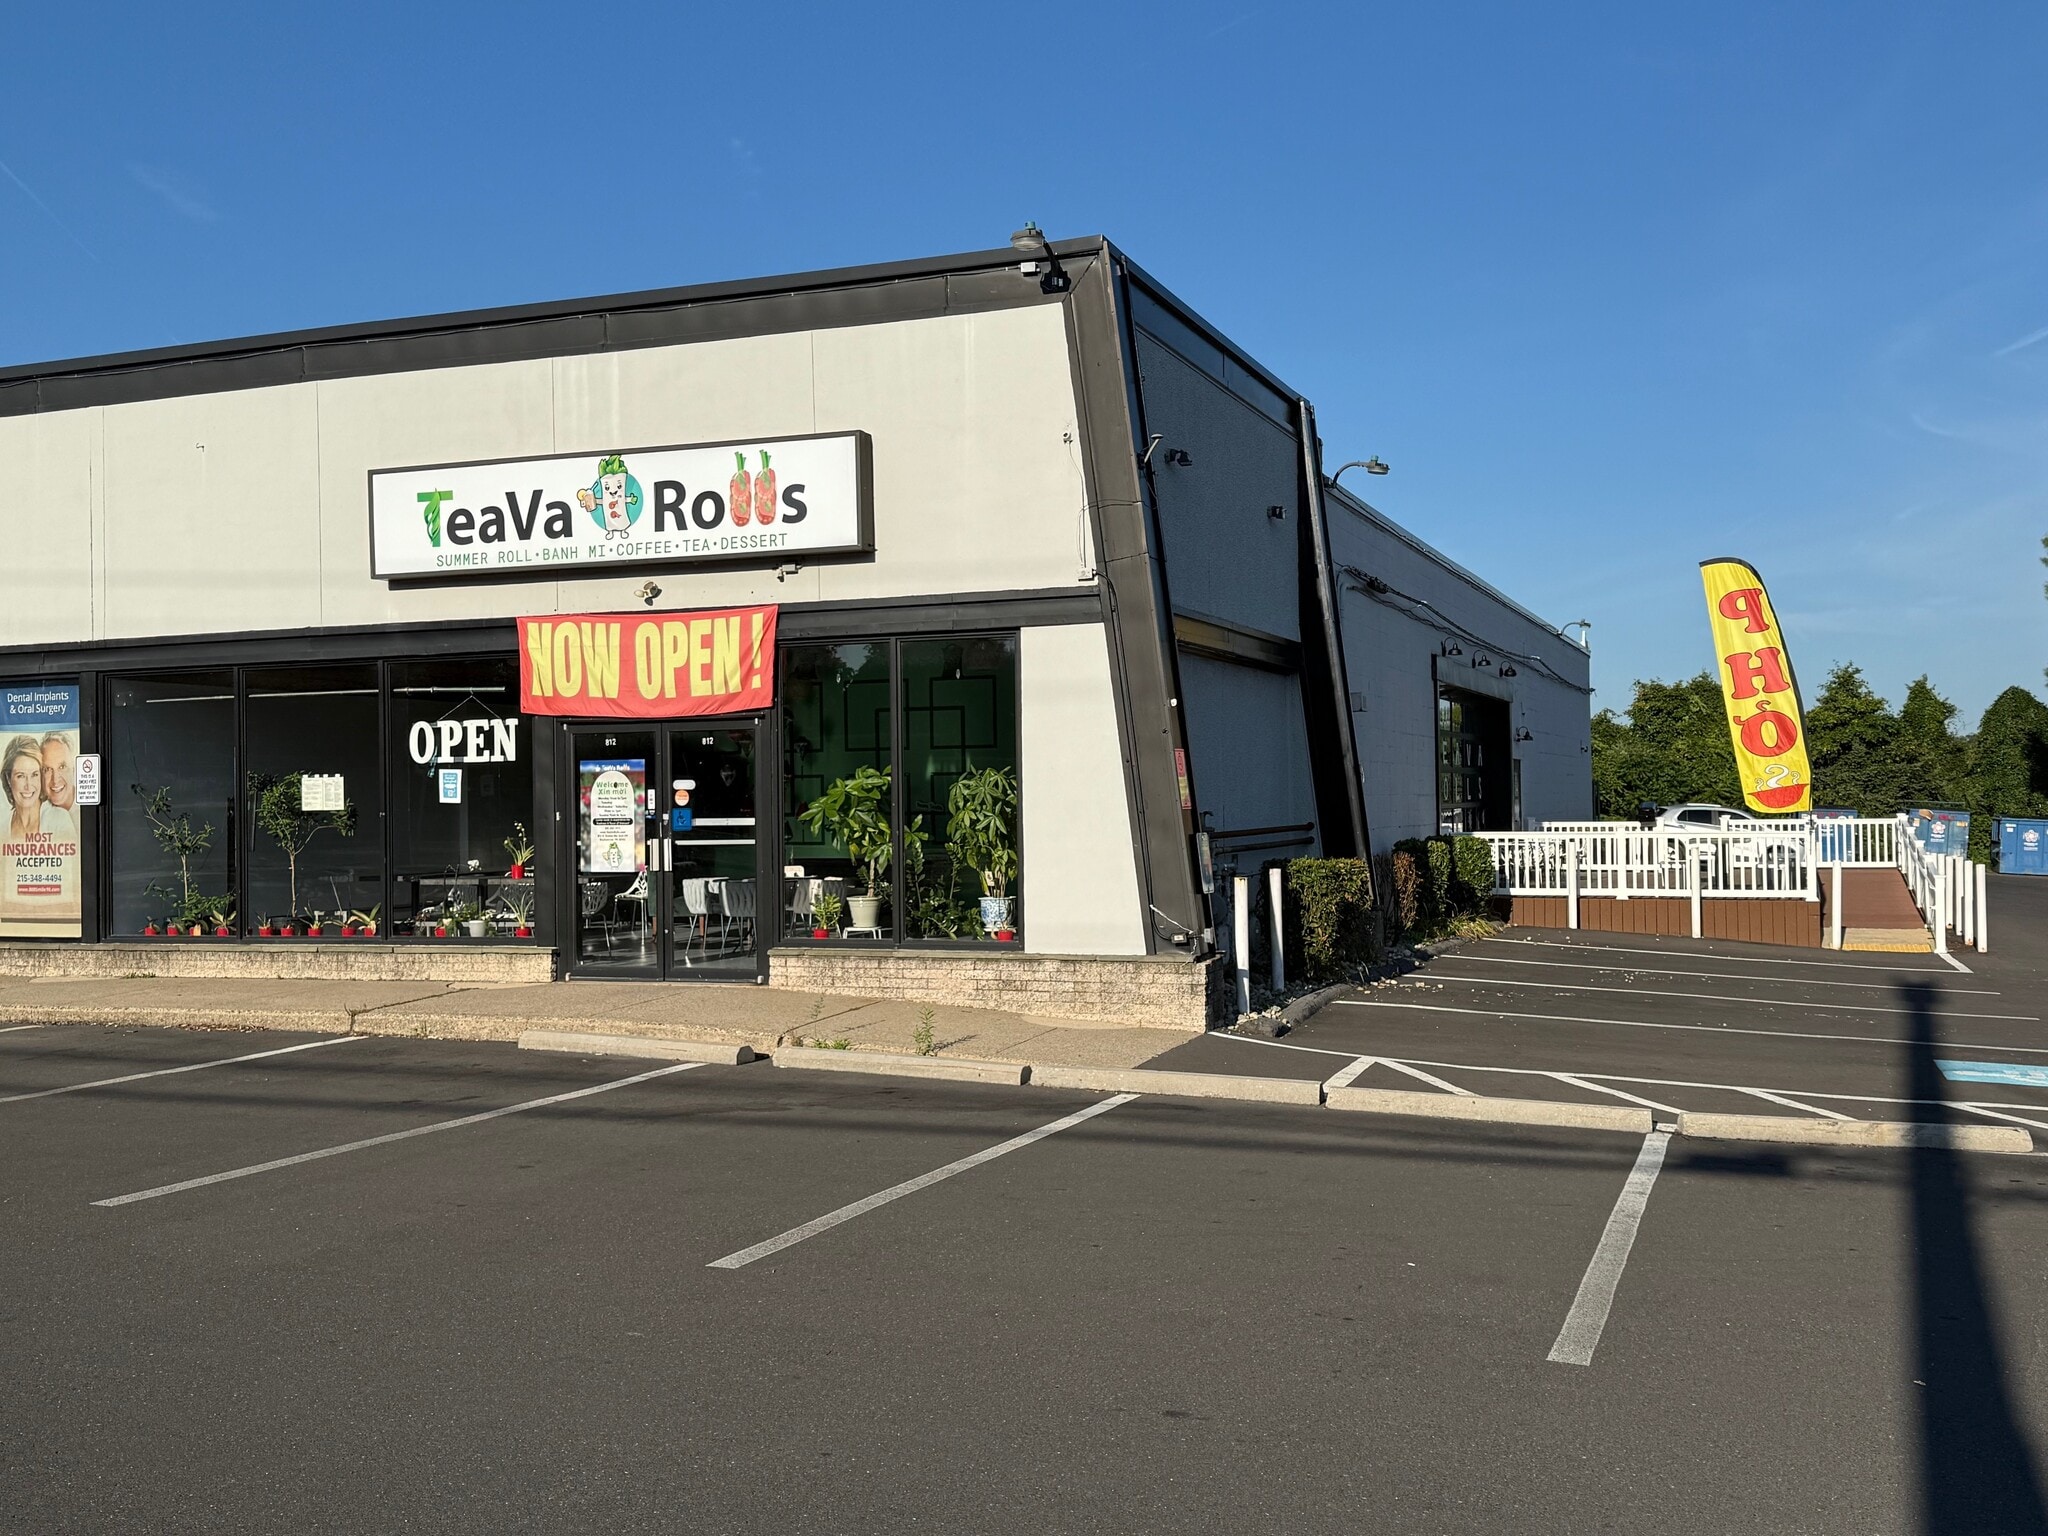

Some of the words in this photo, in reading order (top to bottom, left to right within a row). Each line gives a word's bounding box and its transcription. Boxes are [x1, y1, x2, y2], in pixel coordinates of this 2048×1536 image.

[417, 488, 573, 548] TeaVa
[436, 552, 488, 567] SUMMER
[526, 621, 621, 699] NOW
[7, 692, 33, 703] Dental
[34, 691, 69, 704] Implants
[9, 705, 17, 714] &
[17, 704, 34, 714] Oral
[35, 703, 67, 716] Surgery
[409, 718, 519, 765] OPEN
[605, 738, 617, 746] 812
[701, 737, 714, 746] 812
[1442, 740, 1483, 767] EAVA
[1443, 776, 1483, 801] OLLS
[25, 832, 53, 843] MOST
[2, 843, 76, 857] INSURANCES
[16, 857, 62, 868] ACCEPTED
[16, 874, 62, 883] 215-348-4494
